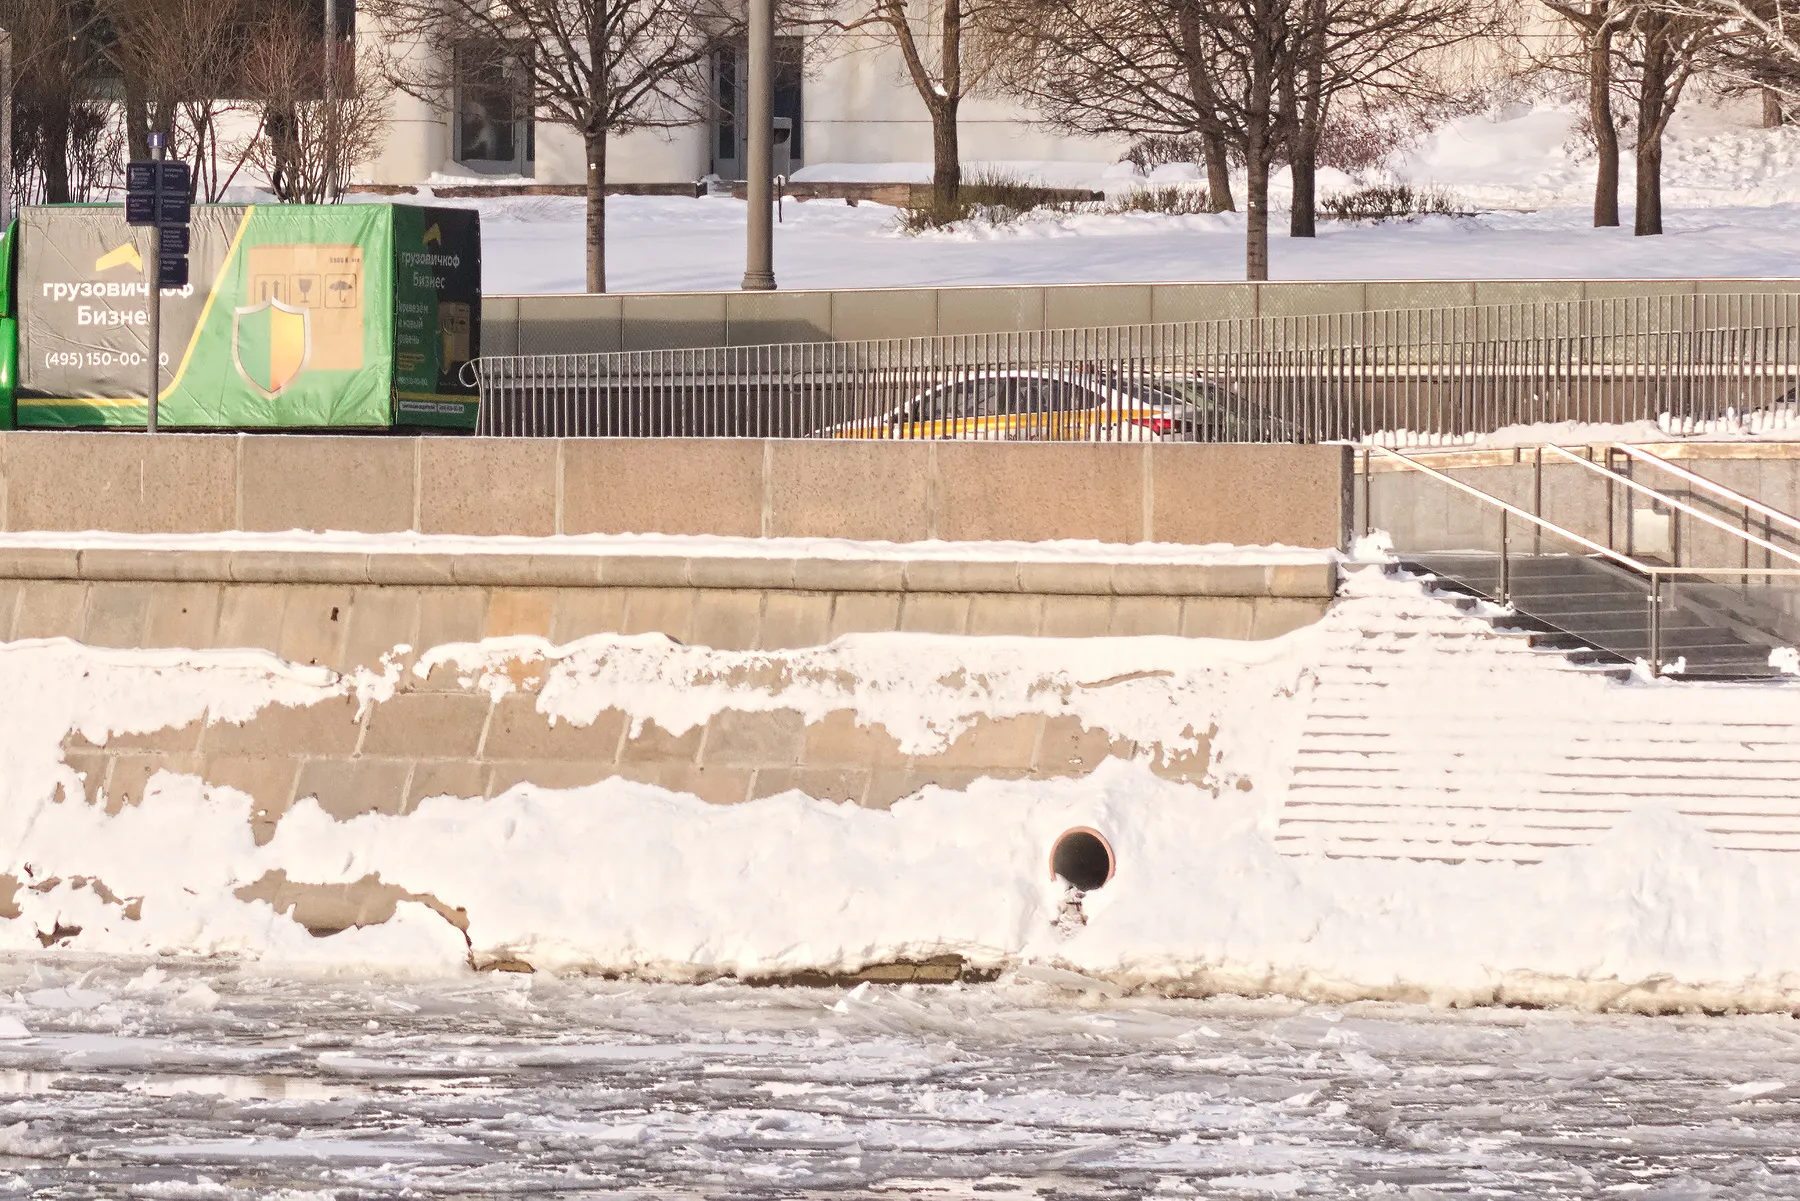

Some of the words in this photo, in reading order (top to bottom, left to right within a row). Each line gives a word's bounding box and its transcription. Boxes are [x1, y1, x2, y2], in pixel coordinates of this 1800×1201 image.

[43, 282, 194, 301] грузовичоф
[78, 306, 150, 325] Бизне
[45, 352, 83, 368] (495)
[86, 352, 169, 365] 150-00-0
